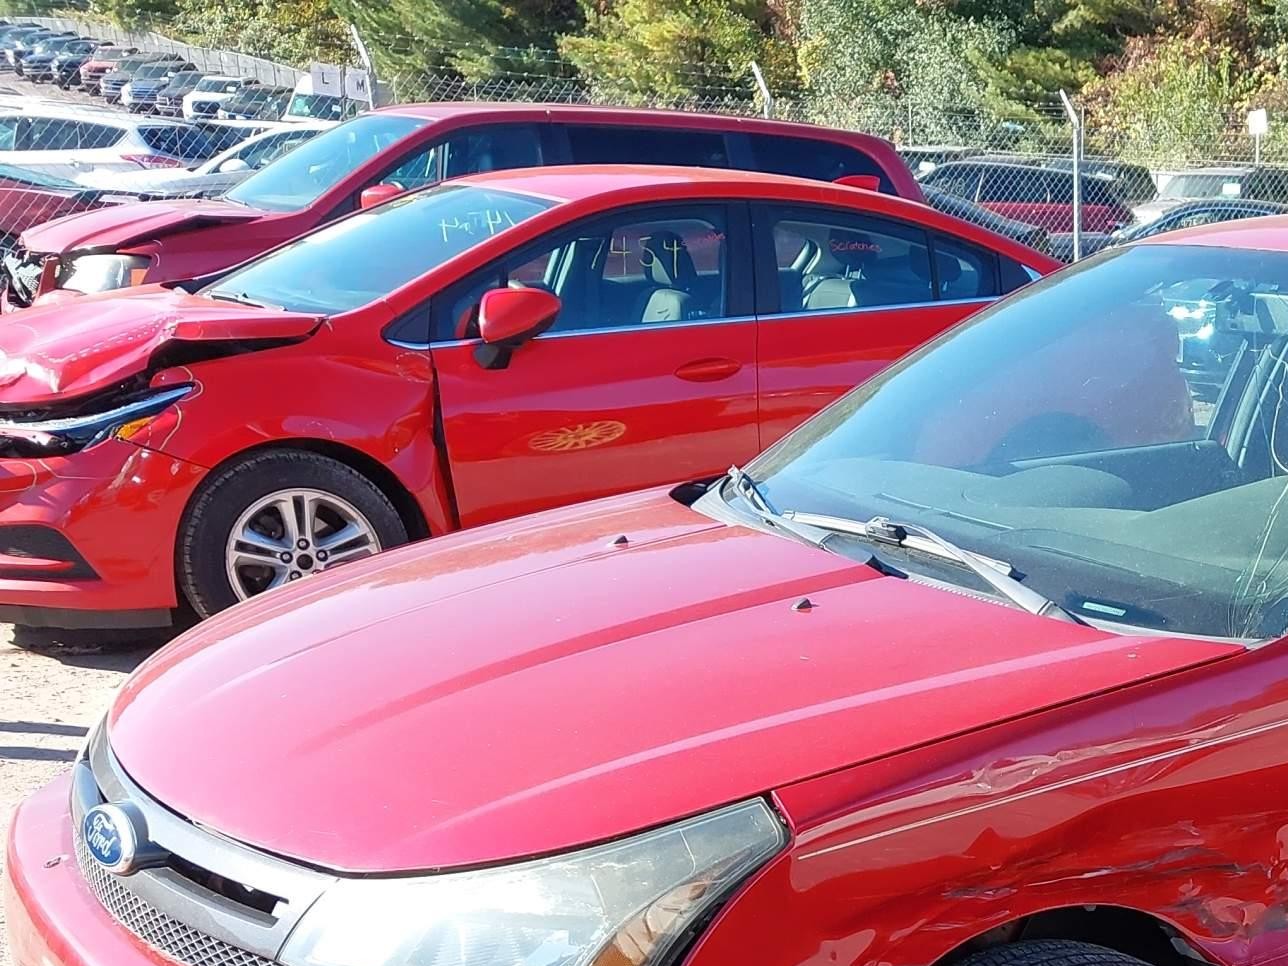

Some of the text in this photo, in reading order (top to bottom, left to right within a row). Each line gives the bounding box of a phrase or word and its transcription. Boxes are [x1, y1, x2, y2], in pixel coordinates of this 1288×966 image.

[321, 71, 330, 85] L
[355, 79, 366, 93] M
[578, 235, 682, 279] 7454
[87, 813, 118, 858] Ford
